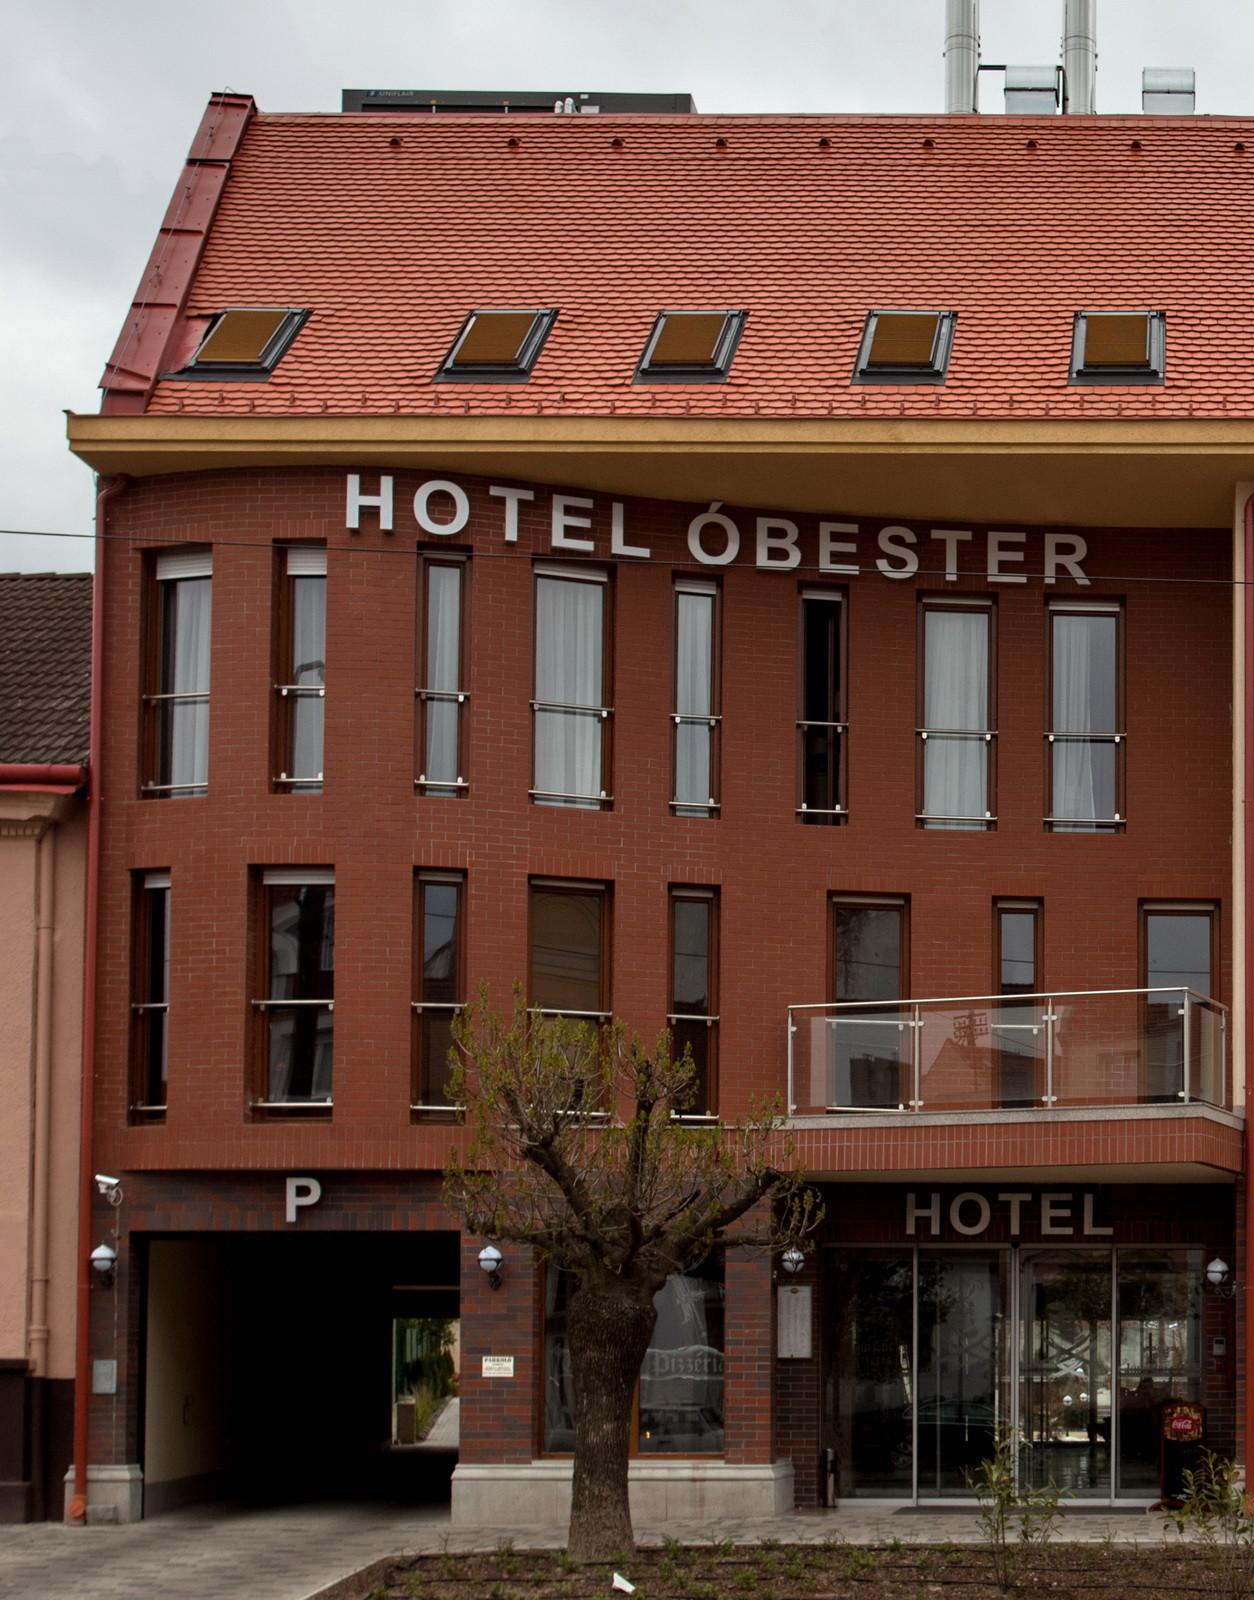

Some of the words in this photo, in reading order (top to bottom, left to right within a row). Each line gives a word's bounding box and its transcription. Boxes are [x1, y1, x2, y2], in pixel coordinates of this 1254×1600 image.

[345, 474, 651, 559] HOTEL
[687, 502, 1091, 586] ÓBESTER
[286, 1177, 321, 1222] P
[906, 1192, 1114, 1235] HOTEL
